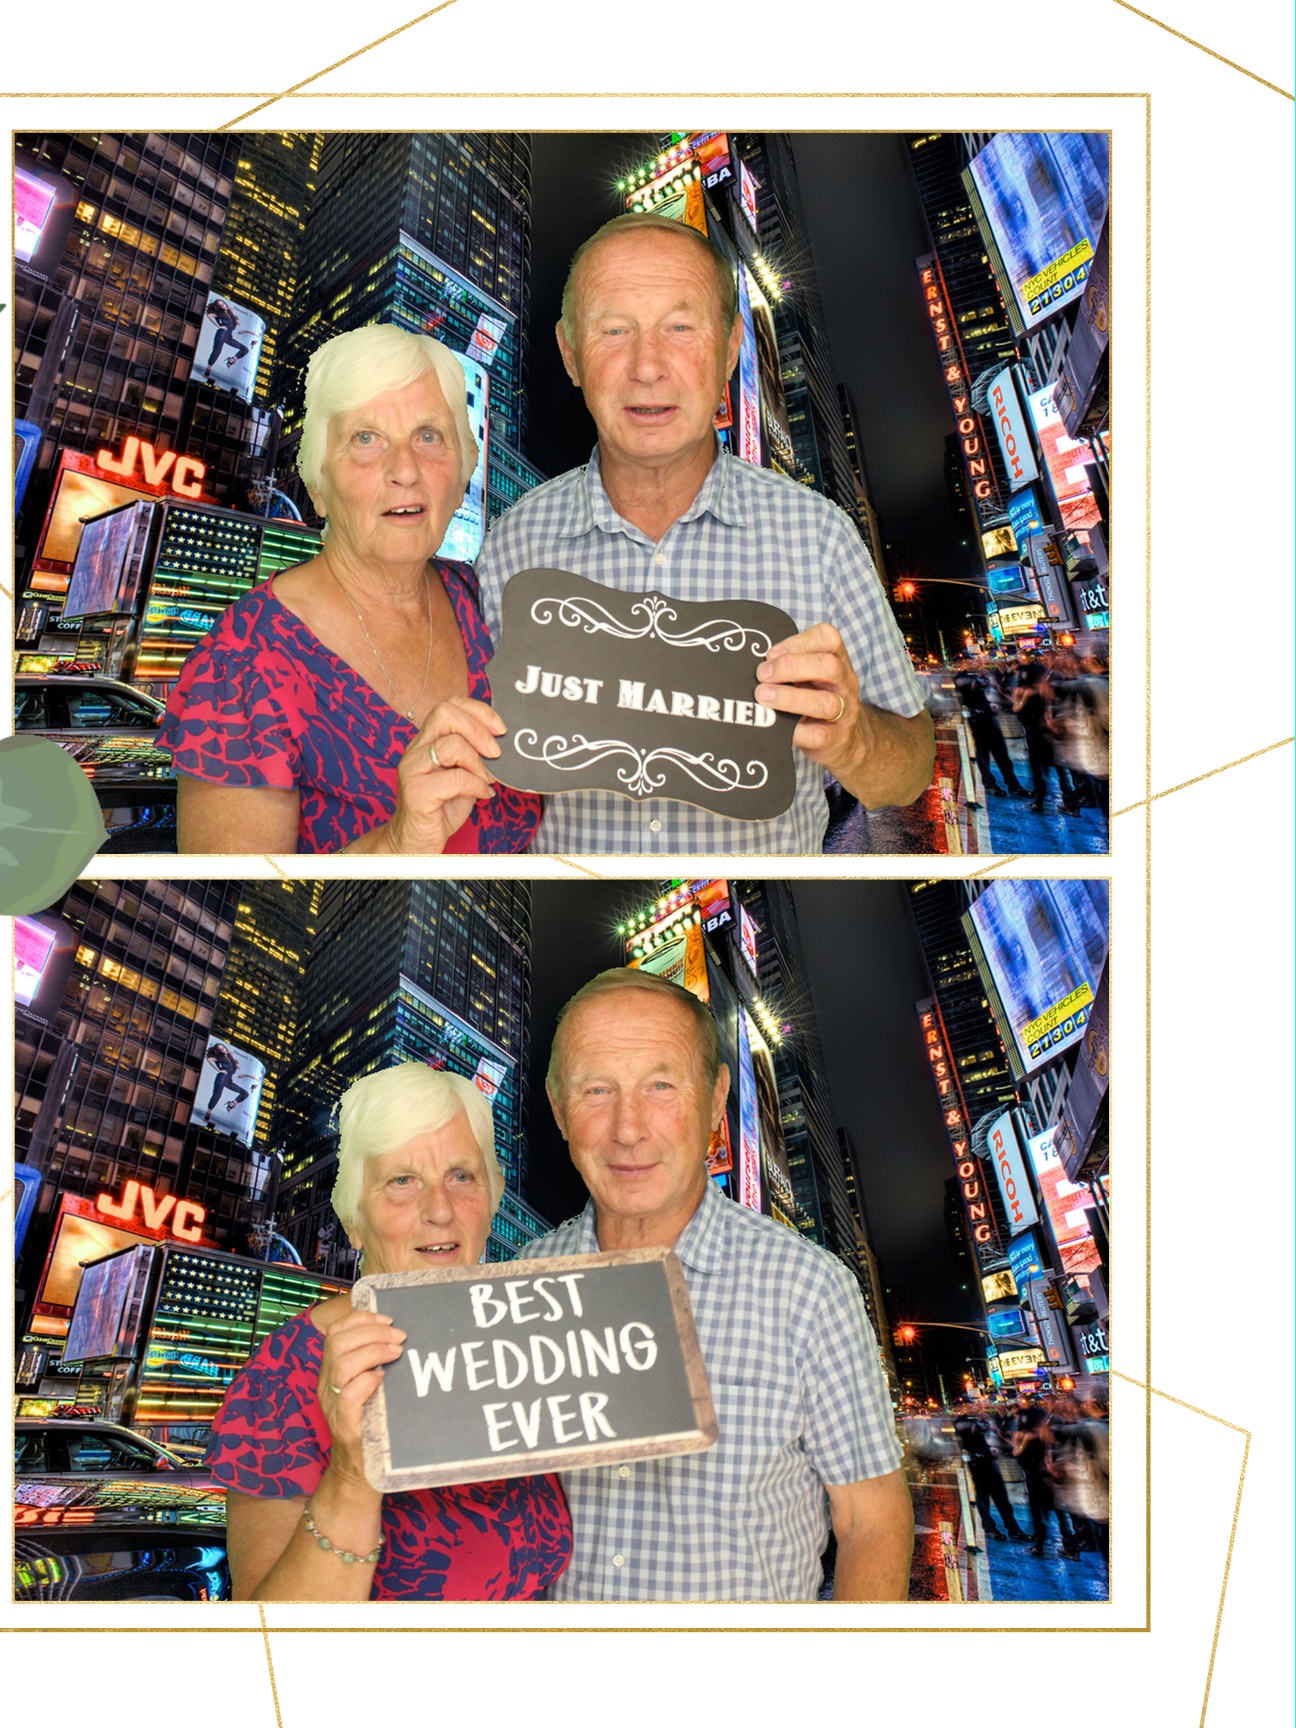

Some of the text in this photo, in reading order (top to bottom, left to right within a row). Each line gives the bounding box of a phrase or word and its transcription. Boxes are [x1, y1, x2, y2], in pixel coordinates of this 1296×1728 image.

[1024, 240, 1089, 292] NYC VEHICLES
[1027, 272, 1058, 299] COUNT
[921, 269, 992, 498] ERNST & YOUNG
[993, 385, 1023, 479] RICOH
[97, 435, 205, 498] JVC
[515, 665, 777, 728] JUST MARRIED
[1024, 984, 1089, 1036] NYC VEHICLES
[1027, 1016, 1058, 1043] COUNT
[921, 1013, 992, 1242] ERNST & YOUNG
[993, 1129, 1023, 1223] RICOH
[97, 1179, 205, 1242] JVC
[469, 1273, 585, 1329] BEST
[407, 1321, 658, 1398] WEDDING
[482, 1392, 618, 1452] EVER
